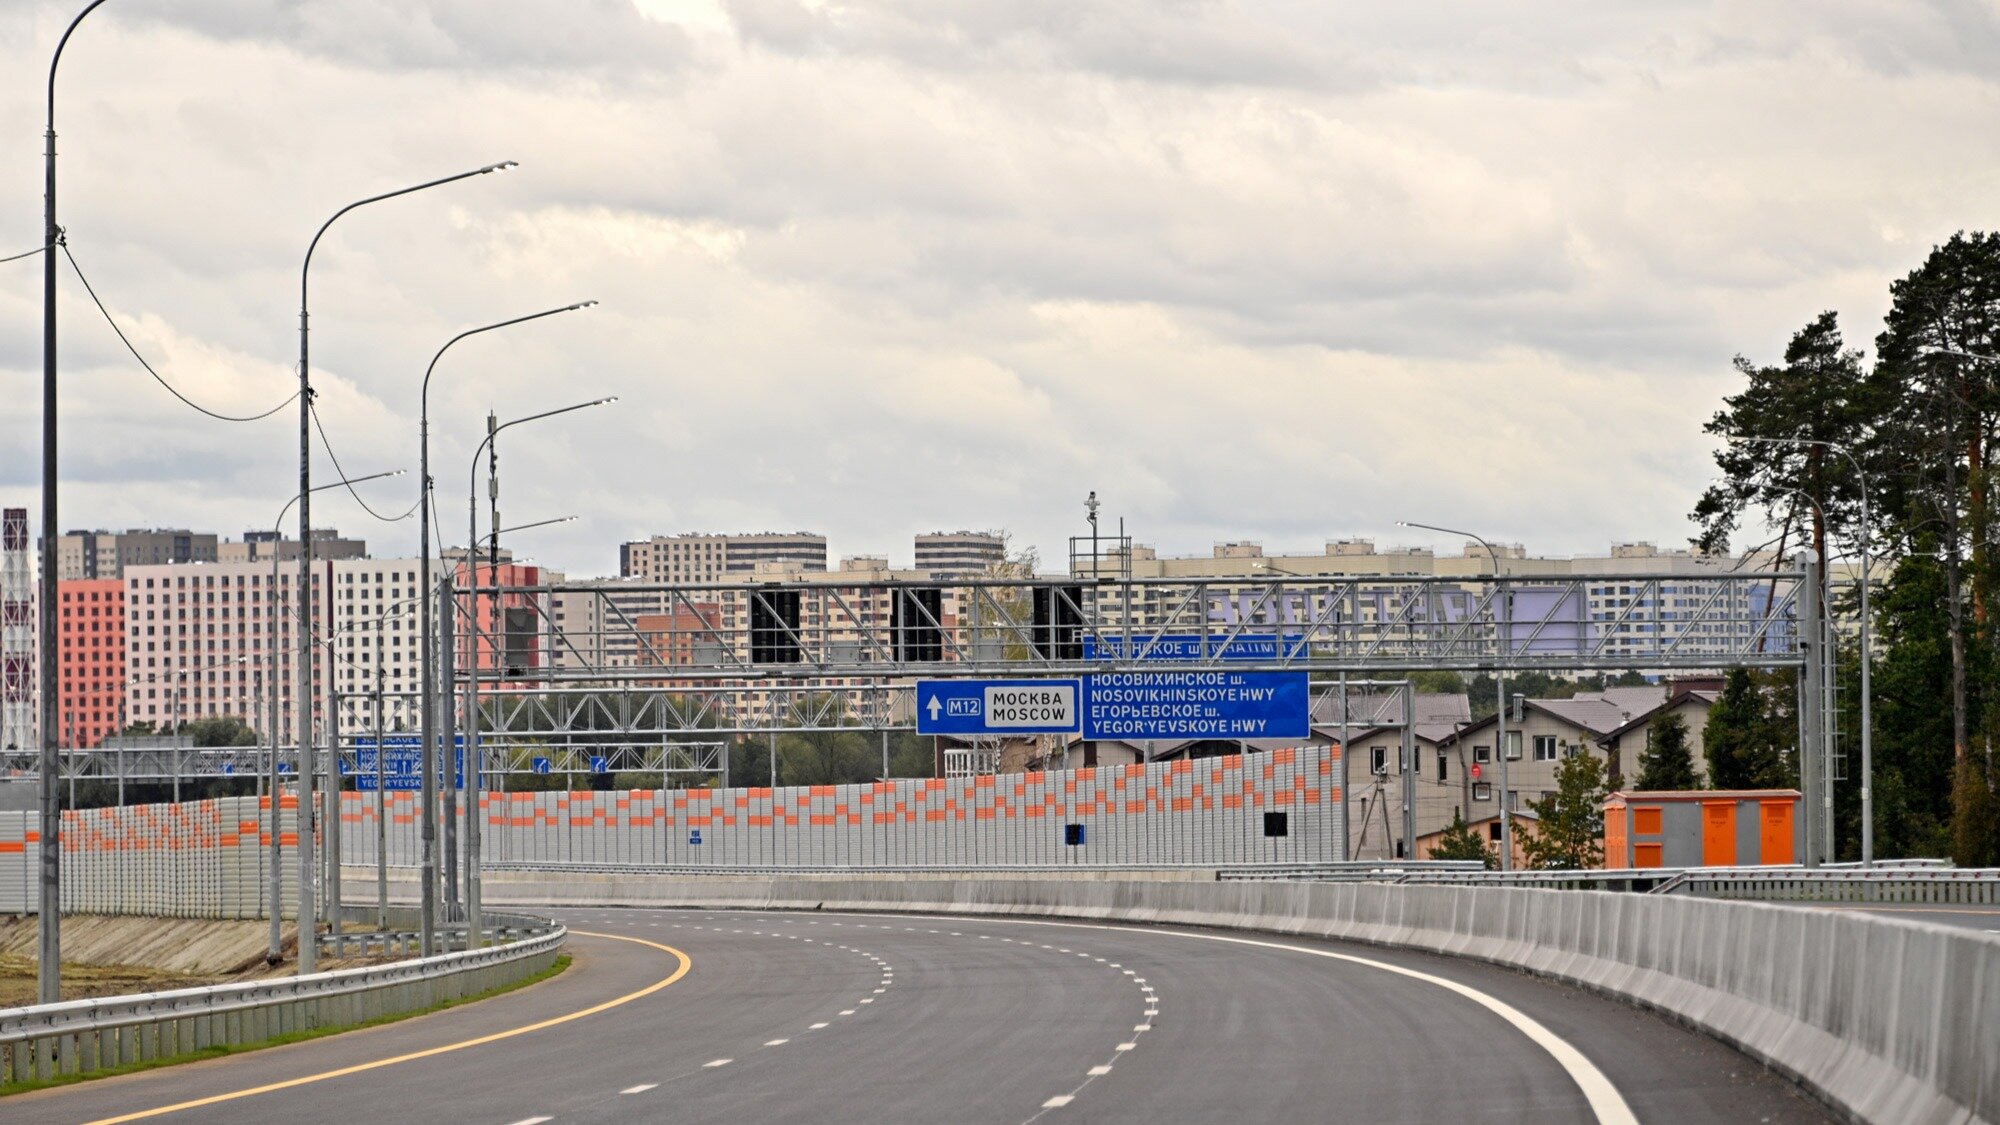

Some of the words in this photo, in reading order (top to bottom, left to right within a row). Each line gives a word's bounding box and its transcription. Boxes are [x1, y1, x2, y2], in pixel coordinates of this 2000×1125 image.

[1091, 673, 1226, 686] НОСОВИХИНСКОЕ
[1230, 676, 1246, 685] ш.
[993, 692, 1063, 705] МОСКВА
[1091, 688, 1237, 702] NOSOVIKHINSKOYE
[1240, 688, 1274, 701] HWY
[993, 708, 1066, 721] MOSCOW
[1091, 704, 1202, 718] ЕГОРЬЕВСКОЕ
[1205, 707, 1221, 717] ш.
[1092, 719, 1228, 733] YEGOR'YEVSKOYE
[1231, 719, 1267, 733] HWY
